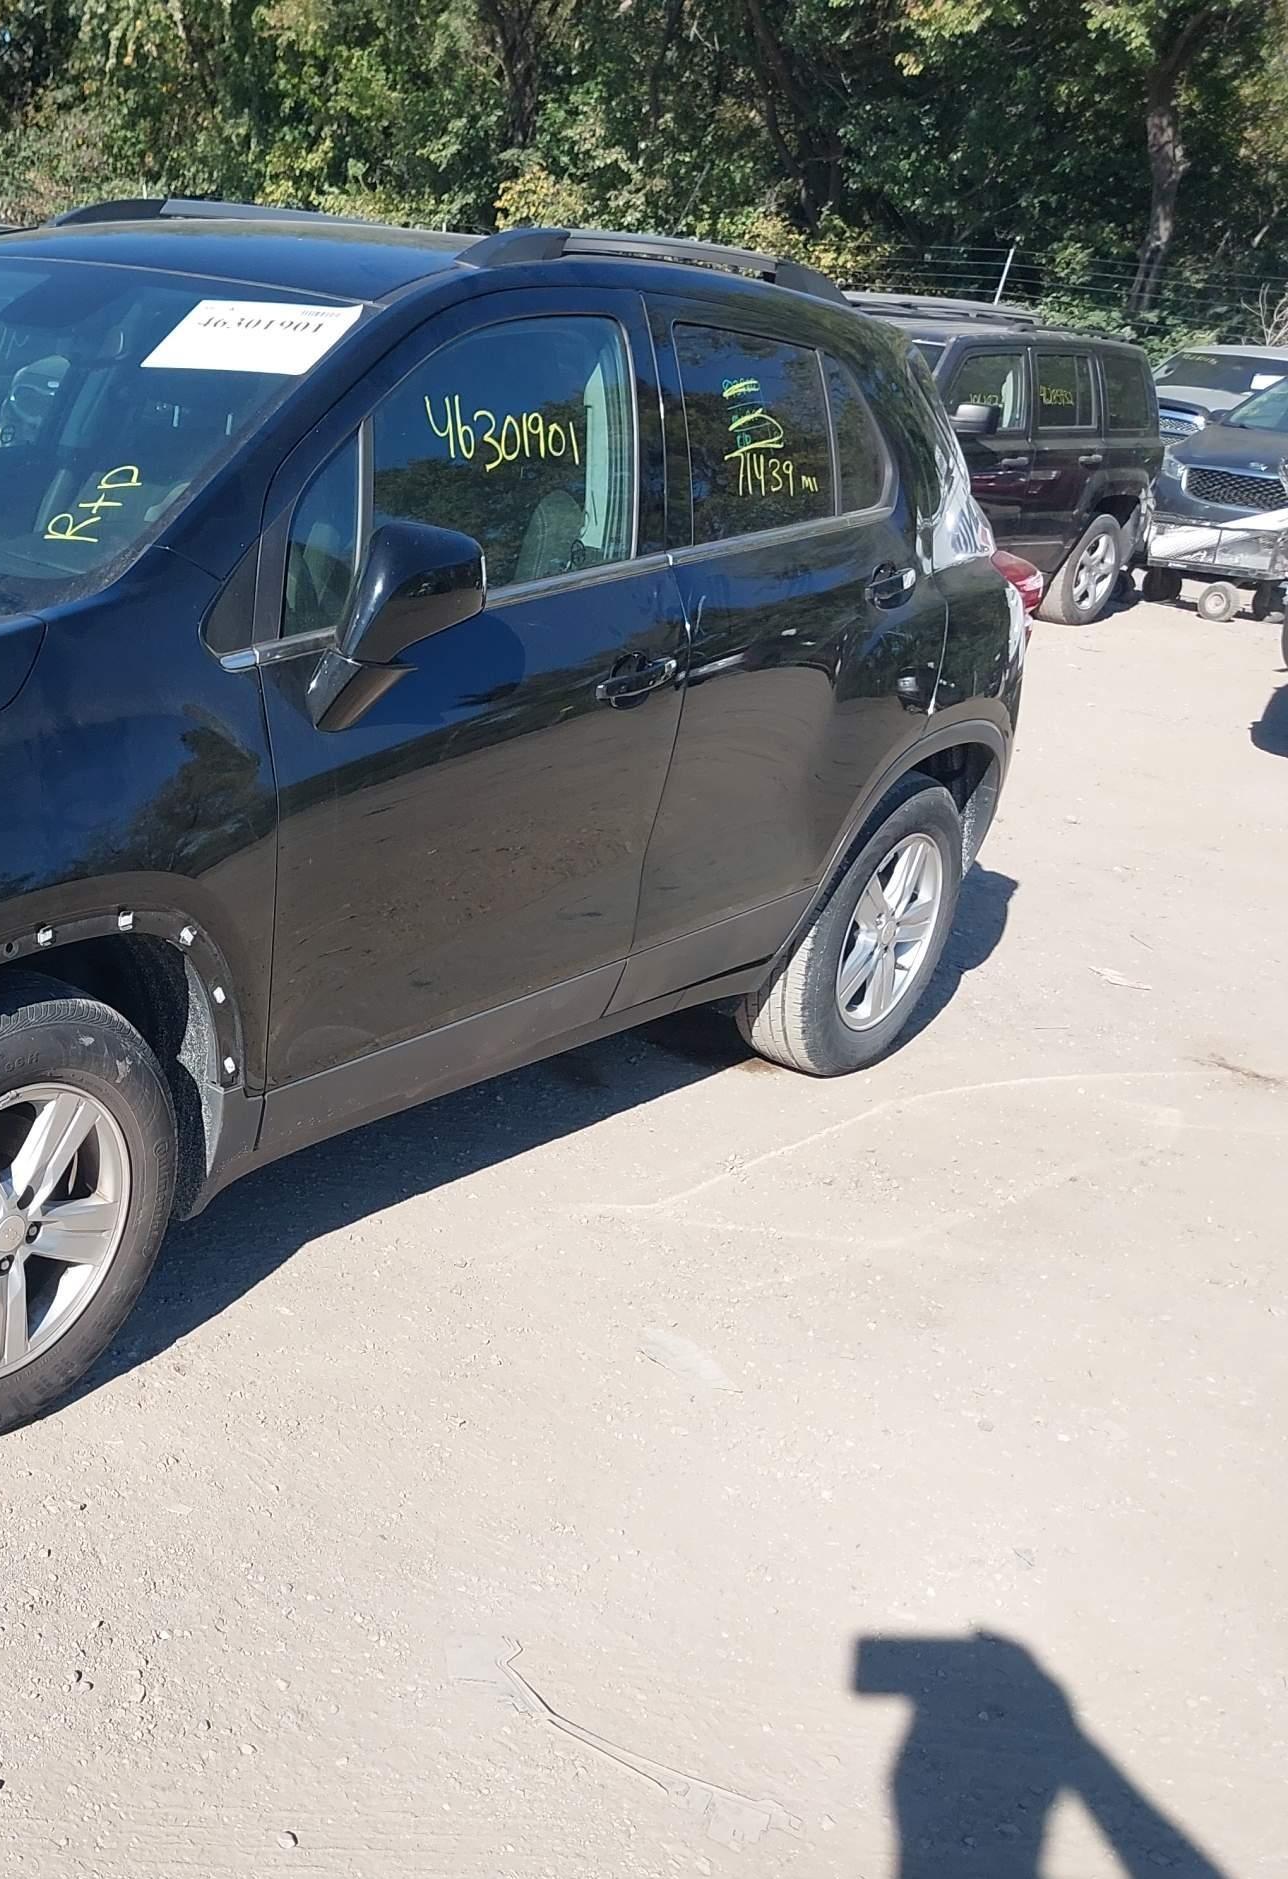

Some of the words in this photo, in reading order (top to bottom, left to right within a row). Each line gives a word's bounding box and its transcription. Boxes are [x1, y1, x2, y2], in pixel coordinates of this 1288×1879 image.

[196, 316, 325, 333] 46301901
[424, 394, 580, 472] 46301901
[724, 452, 794, 497] 71439
